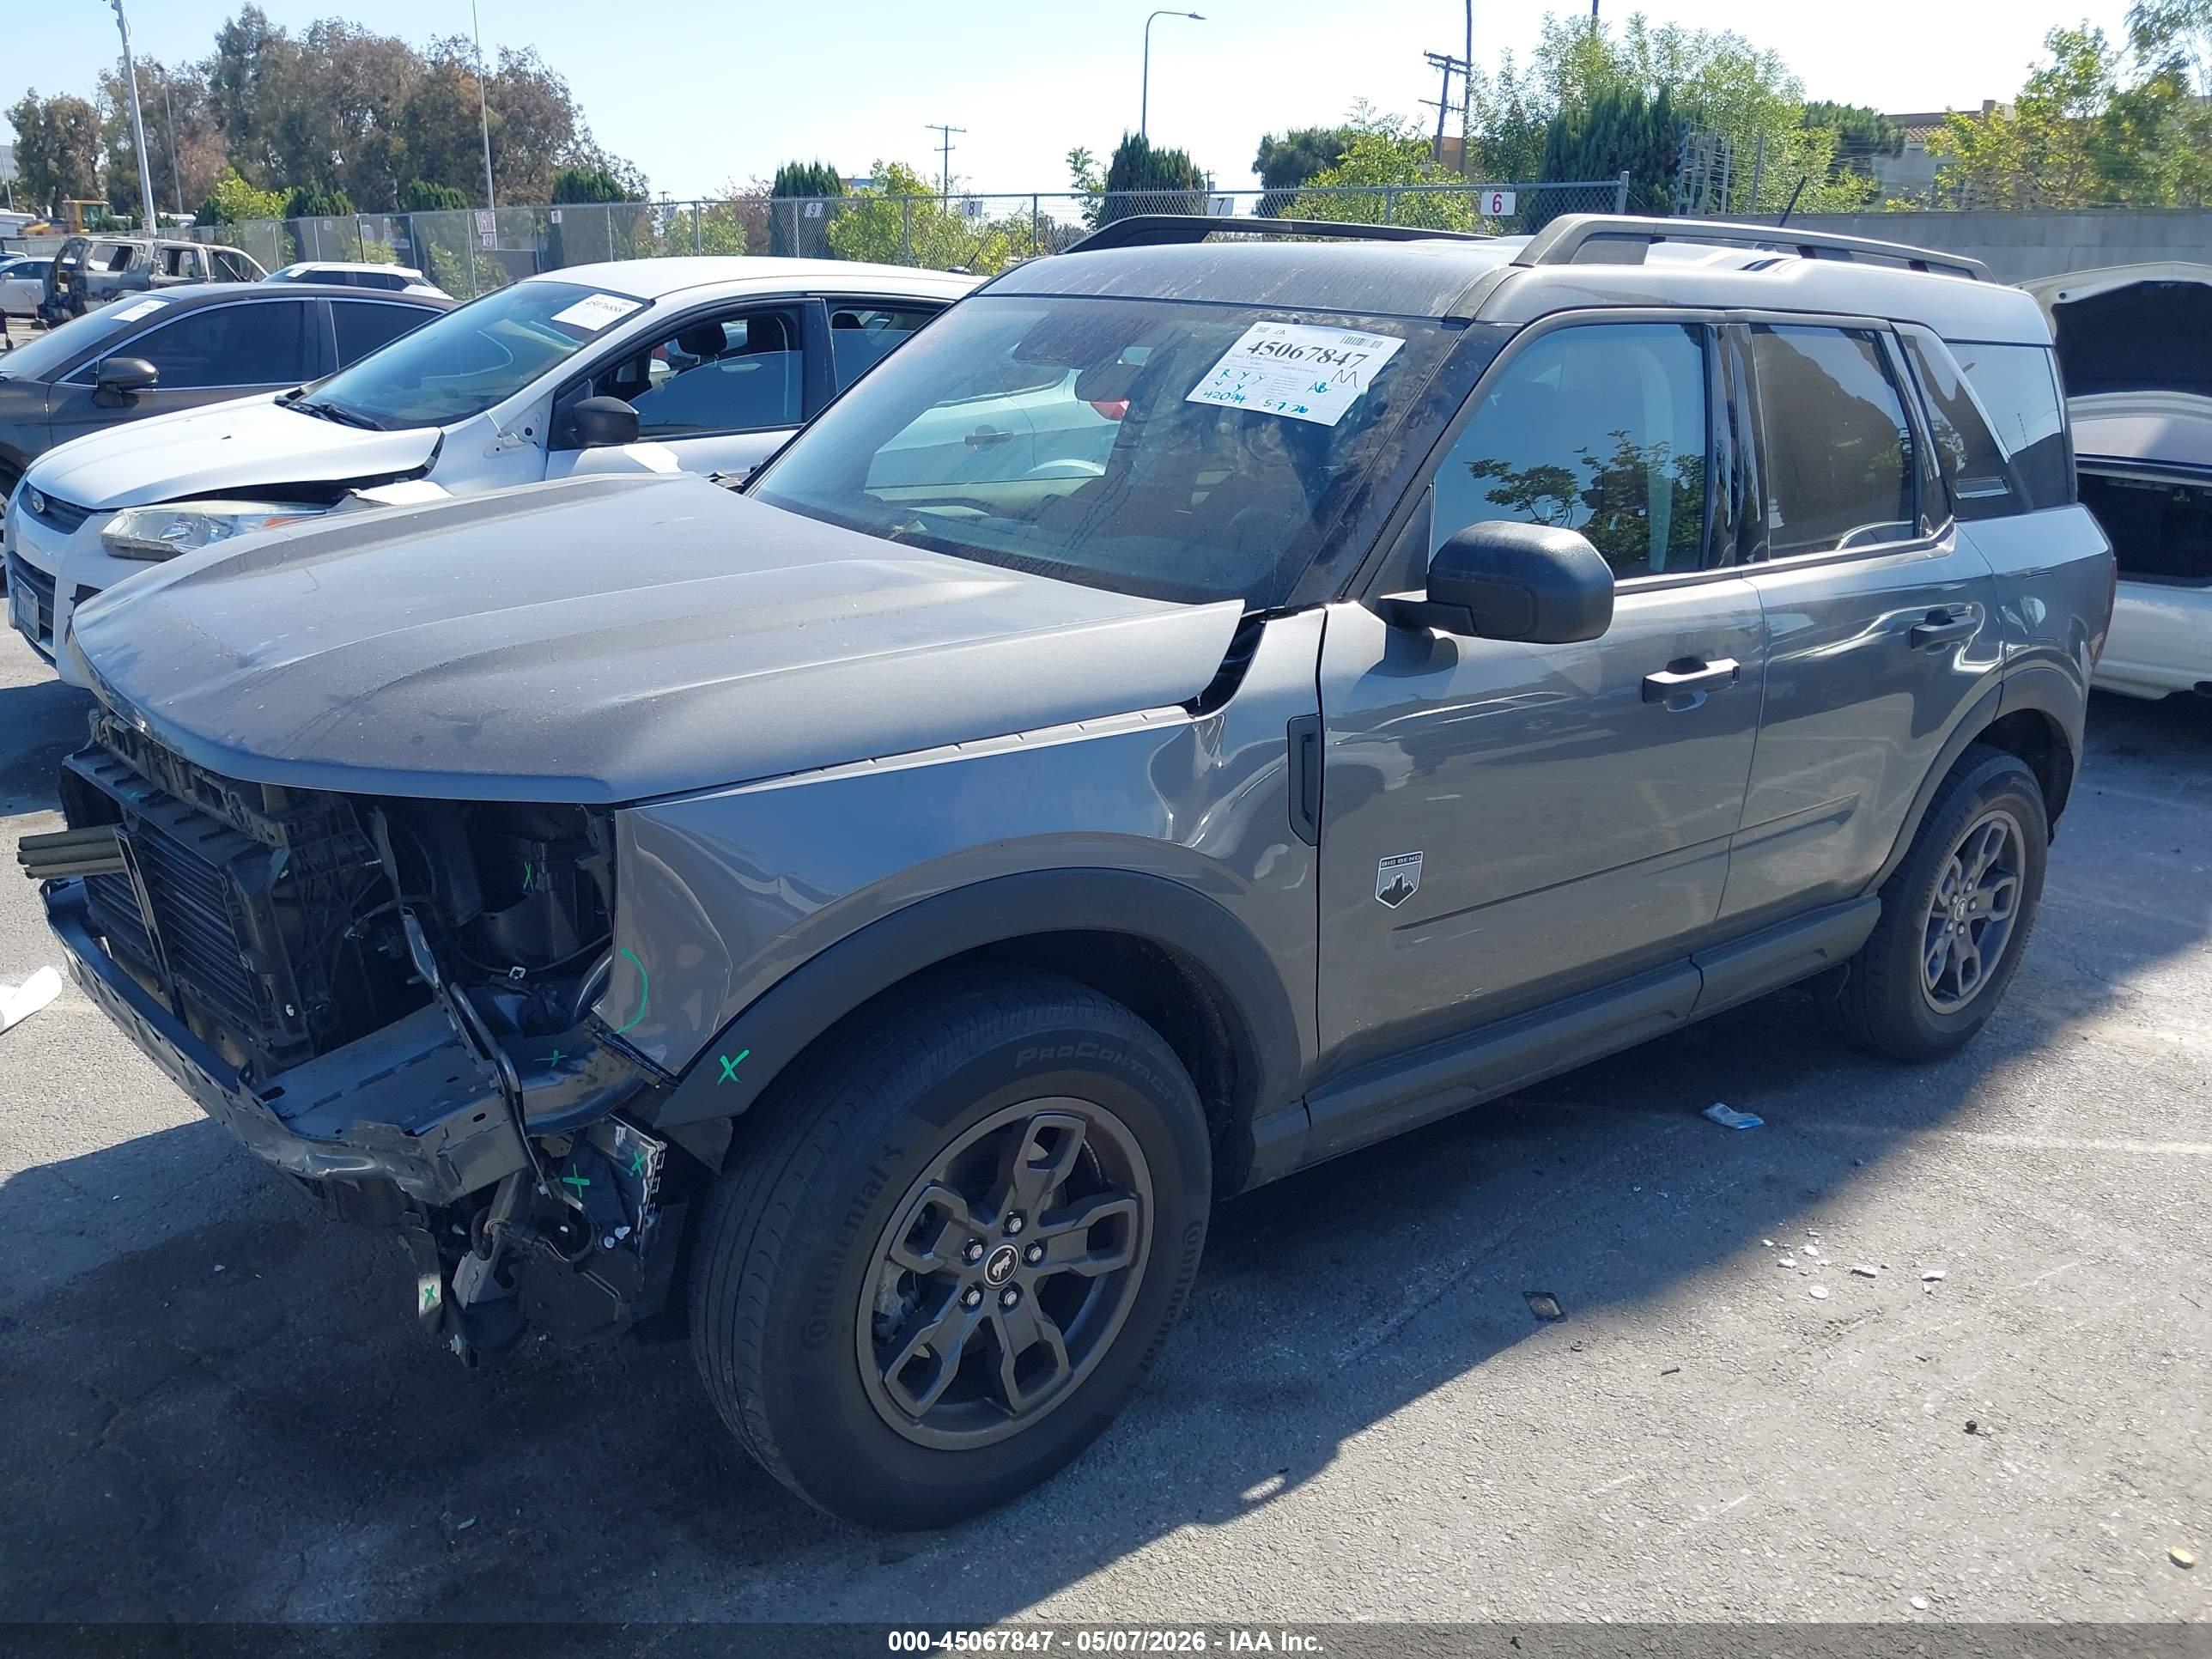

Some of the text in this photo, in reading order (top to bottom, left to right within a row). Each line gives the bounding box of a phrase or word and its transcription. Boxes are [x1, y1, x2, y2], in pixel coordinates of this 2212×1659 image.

[810, 204, 817, 216] 9
[968, 201, 975, 216] 8
[1217, 198, 1225, 215] 7
[1492, 193, 1503, 214] 6
[1246, 339, 1370, 369] 45067847
[1398, 855, 1420, 864] BEND
